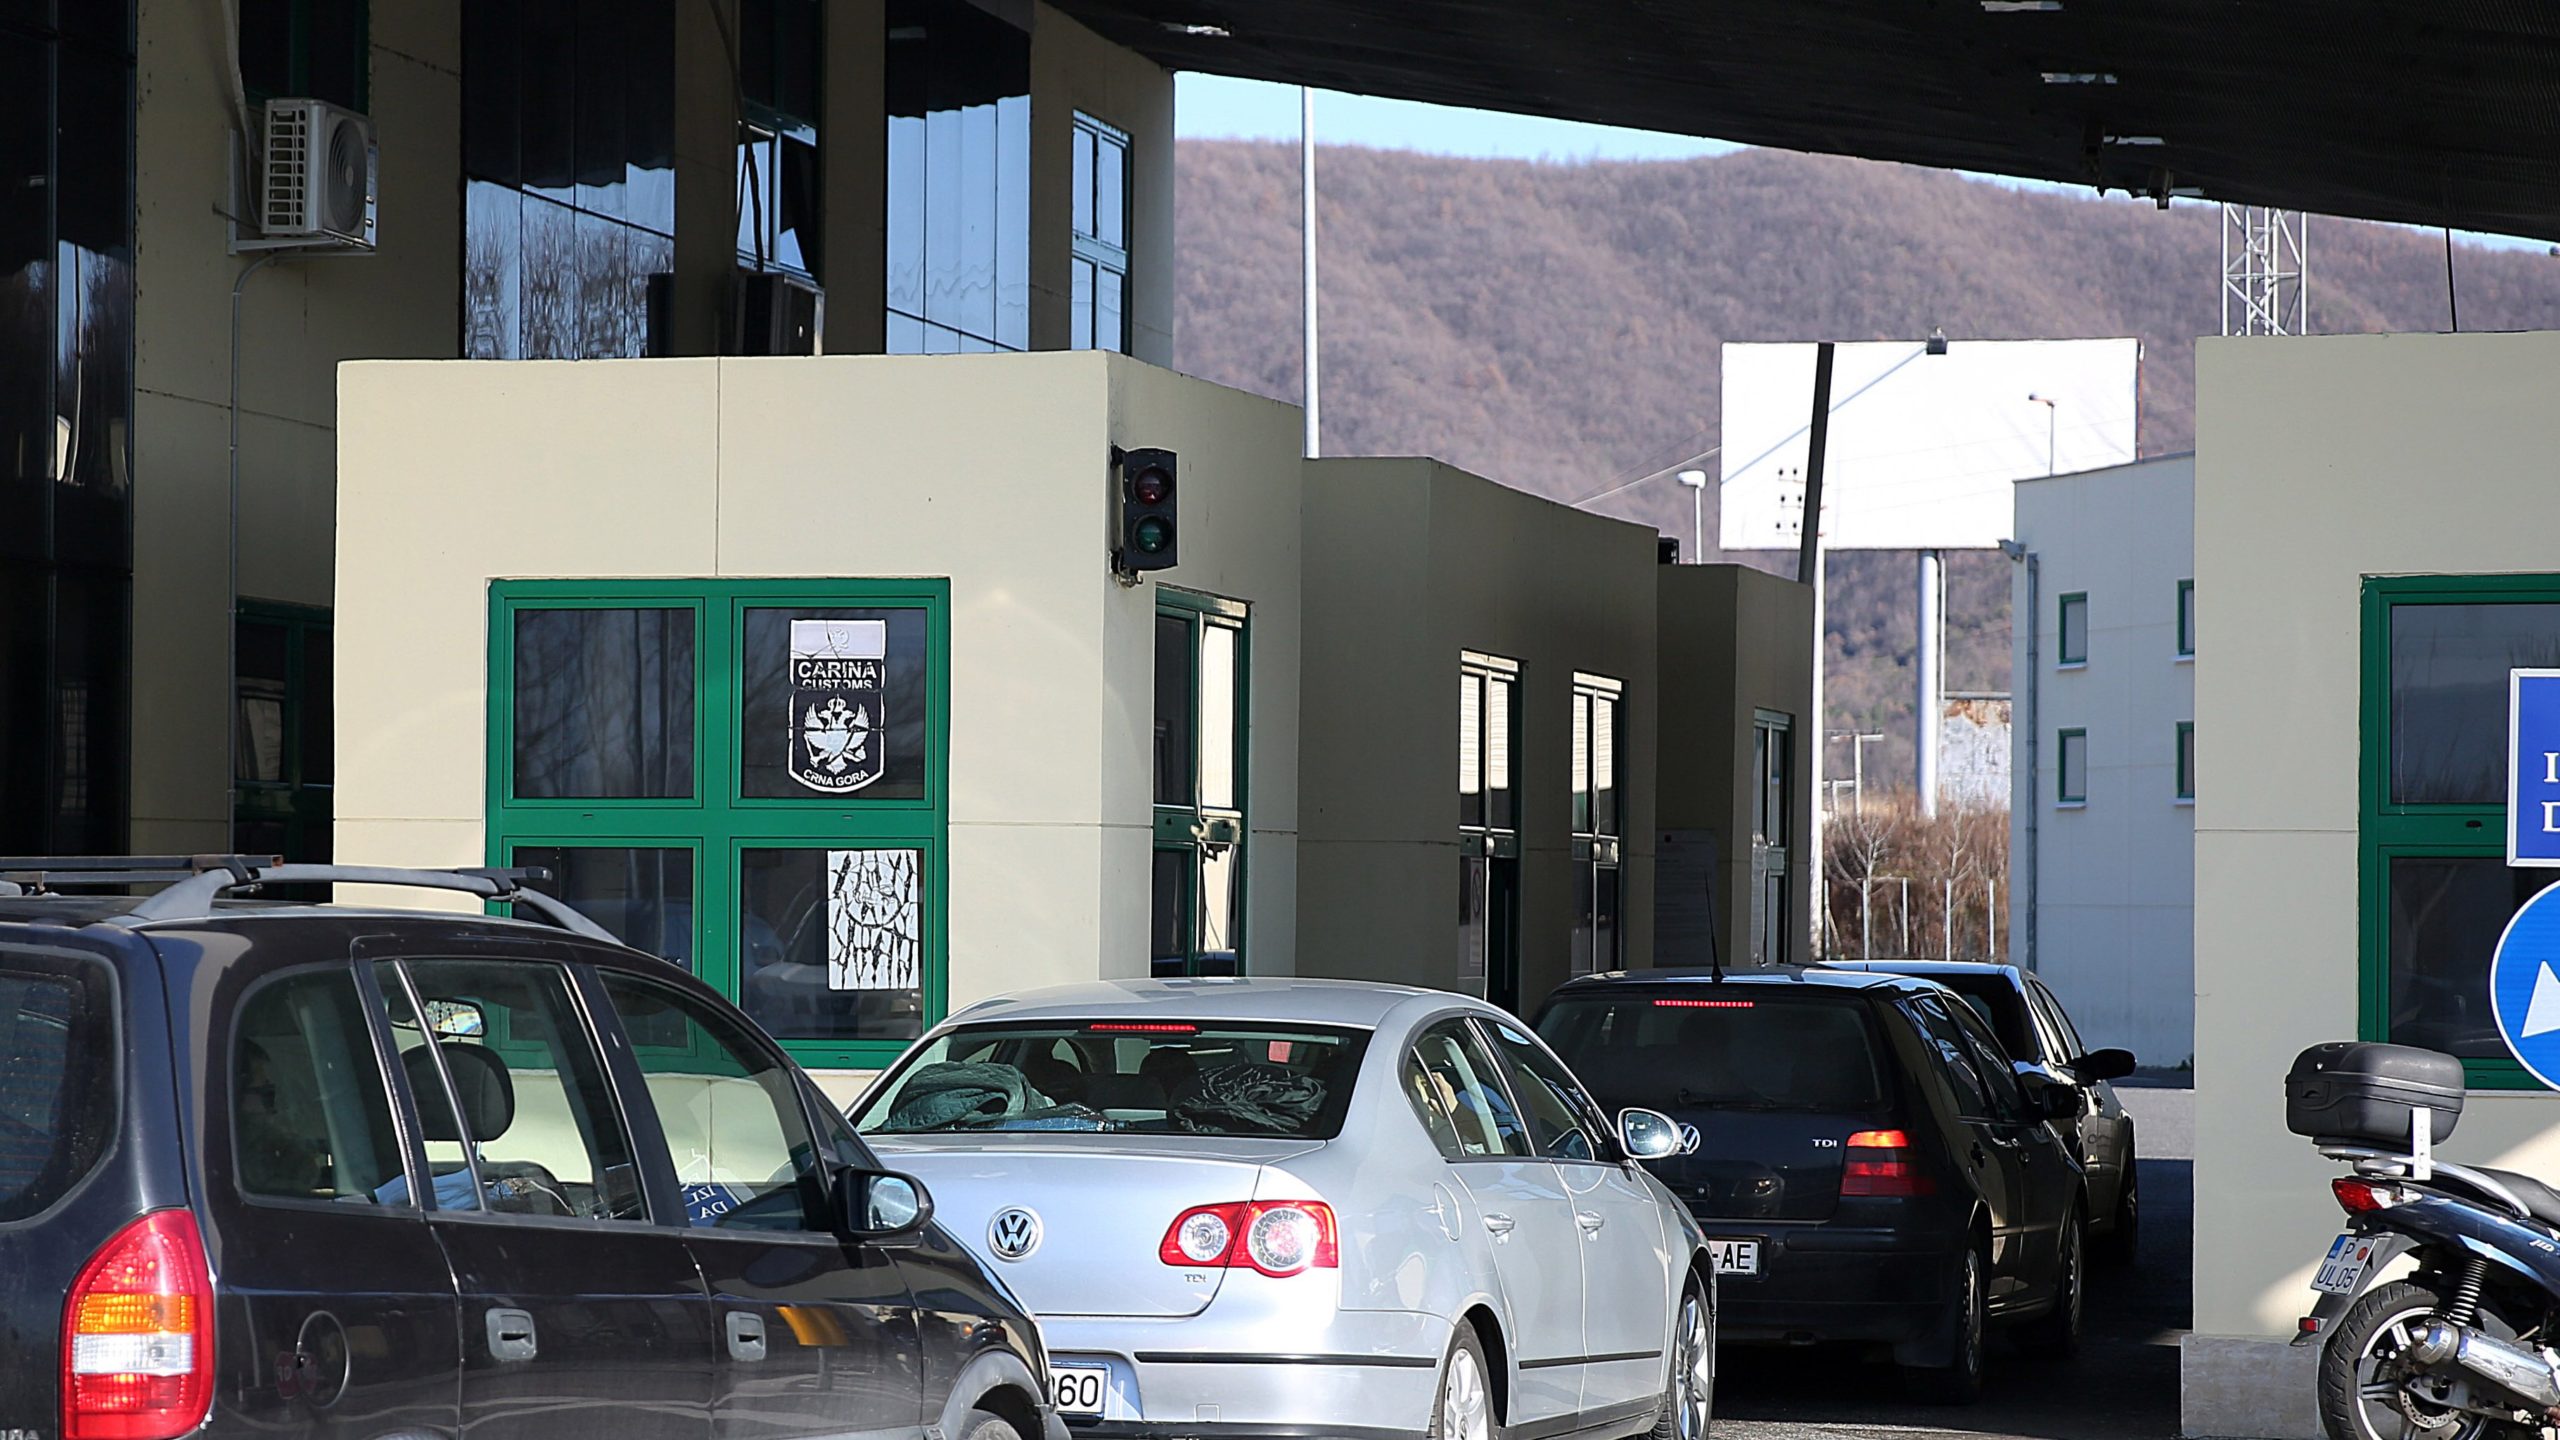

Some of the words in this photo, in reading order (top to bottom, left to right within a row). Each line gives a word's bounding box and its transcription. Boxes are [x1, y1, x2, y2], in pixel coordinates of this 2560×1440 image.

[798, 661, 878, 680] CARINA
[802, 679, 873, 690] CUSTOMS
[803, 769, 835, 787] CRNA
[835, 769, 869, 787] GORA
[1812, 1138, 1838, 1148] TDI
[2340, 1242, 2356, 1262] P
[2317, 1264, 2337, 1287] UL
[2335, 1266, 2359, 1288] 05
[1050, 1374, 1099, 1408] 60
